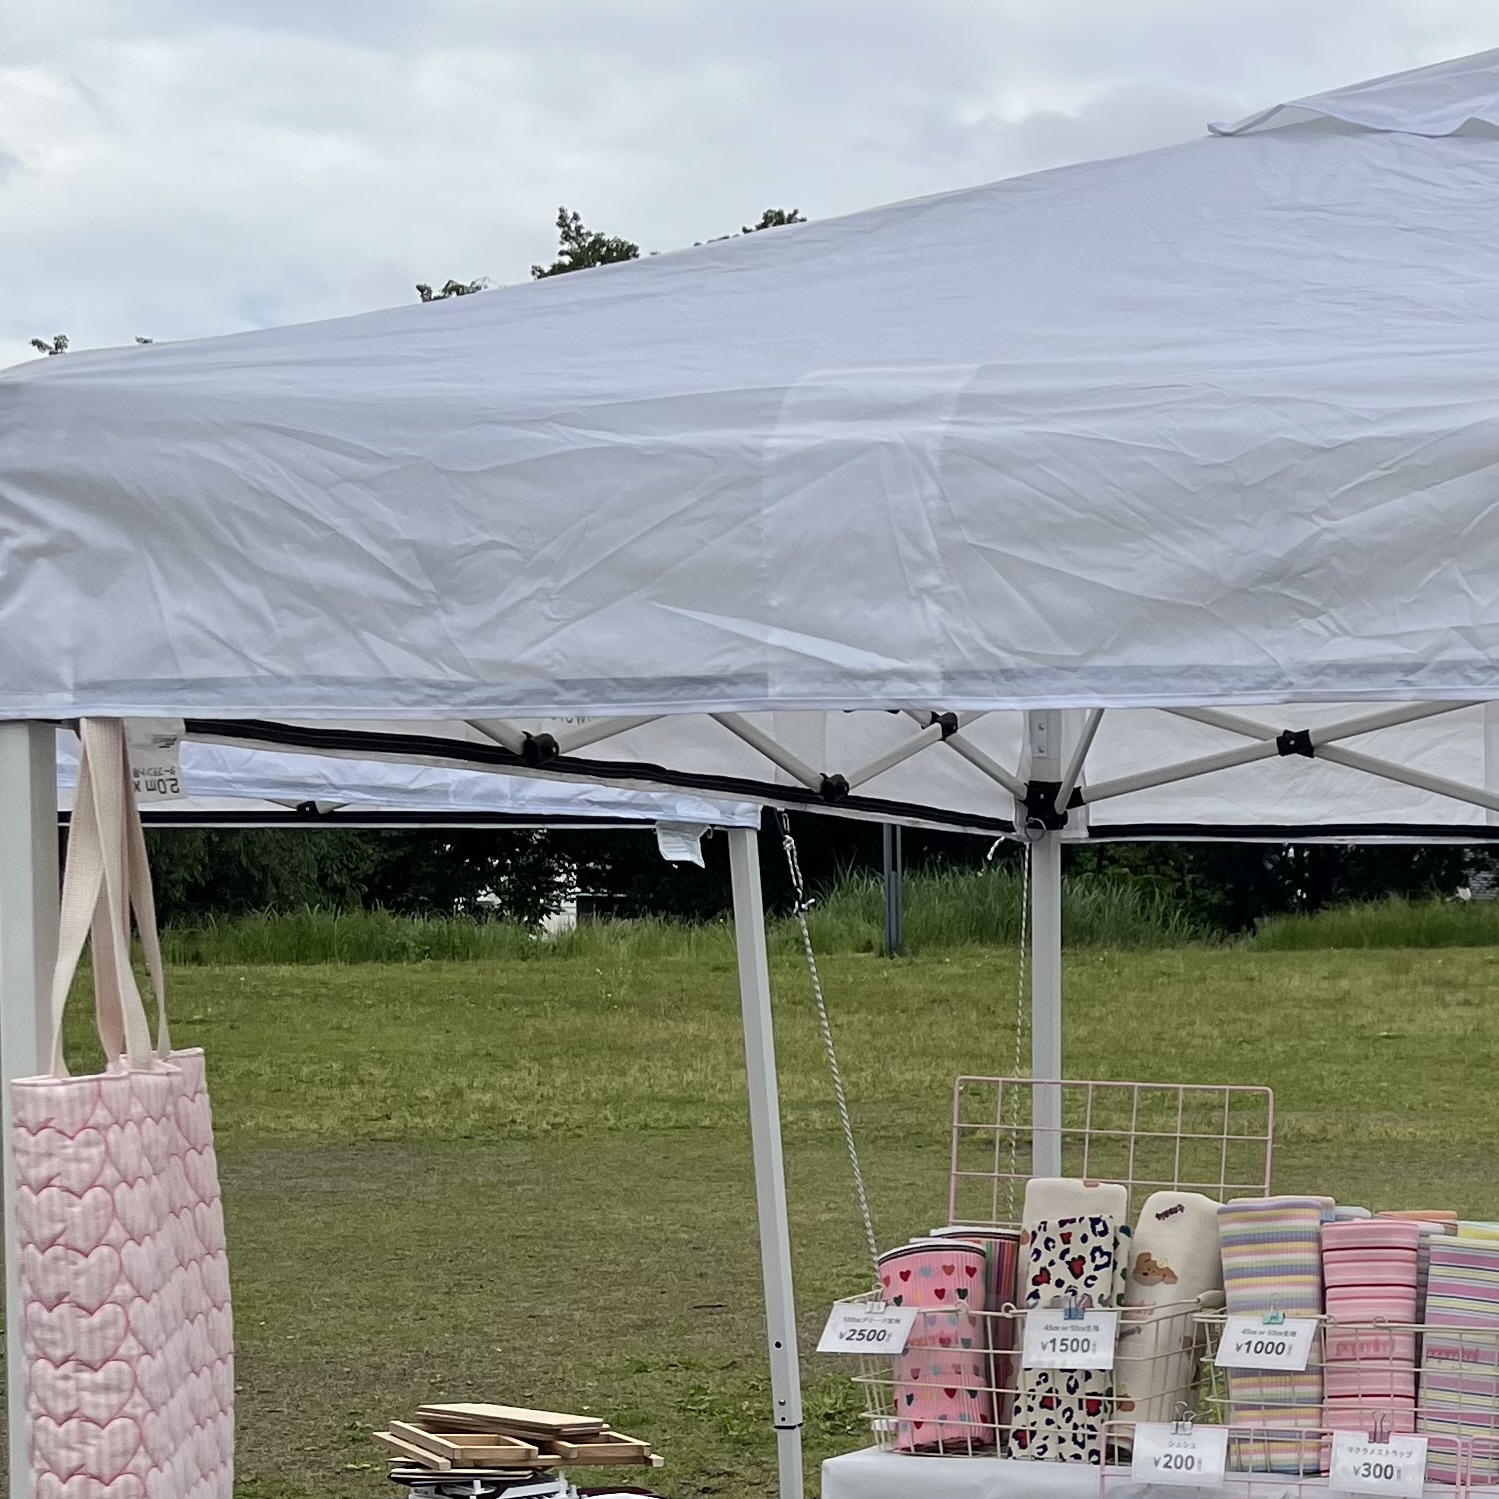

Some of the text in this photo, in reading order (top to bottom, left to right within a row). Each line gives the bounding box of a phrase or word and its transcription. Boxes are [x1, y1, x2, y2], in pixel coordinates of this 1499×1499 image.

[839, 1328, 887, 1342] ¥2500
[1040, 1337, 1091, 1353] ¥1500
[1235, 1340, 1286, 1355] ¥1000
[1153, 1453, 1195, 1471] ¥200
[1353, 1462, 1394, 1480] ¥300
